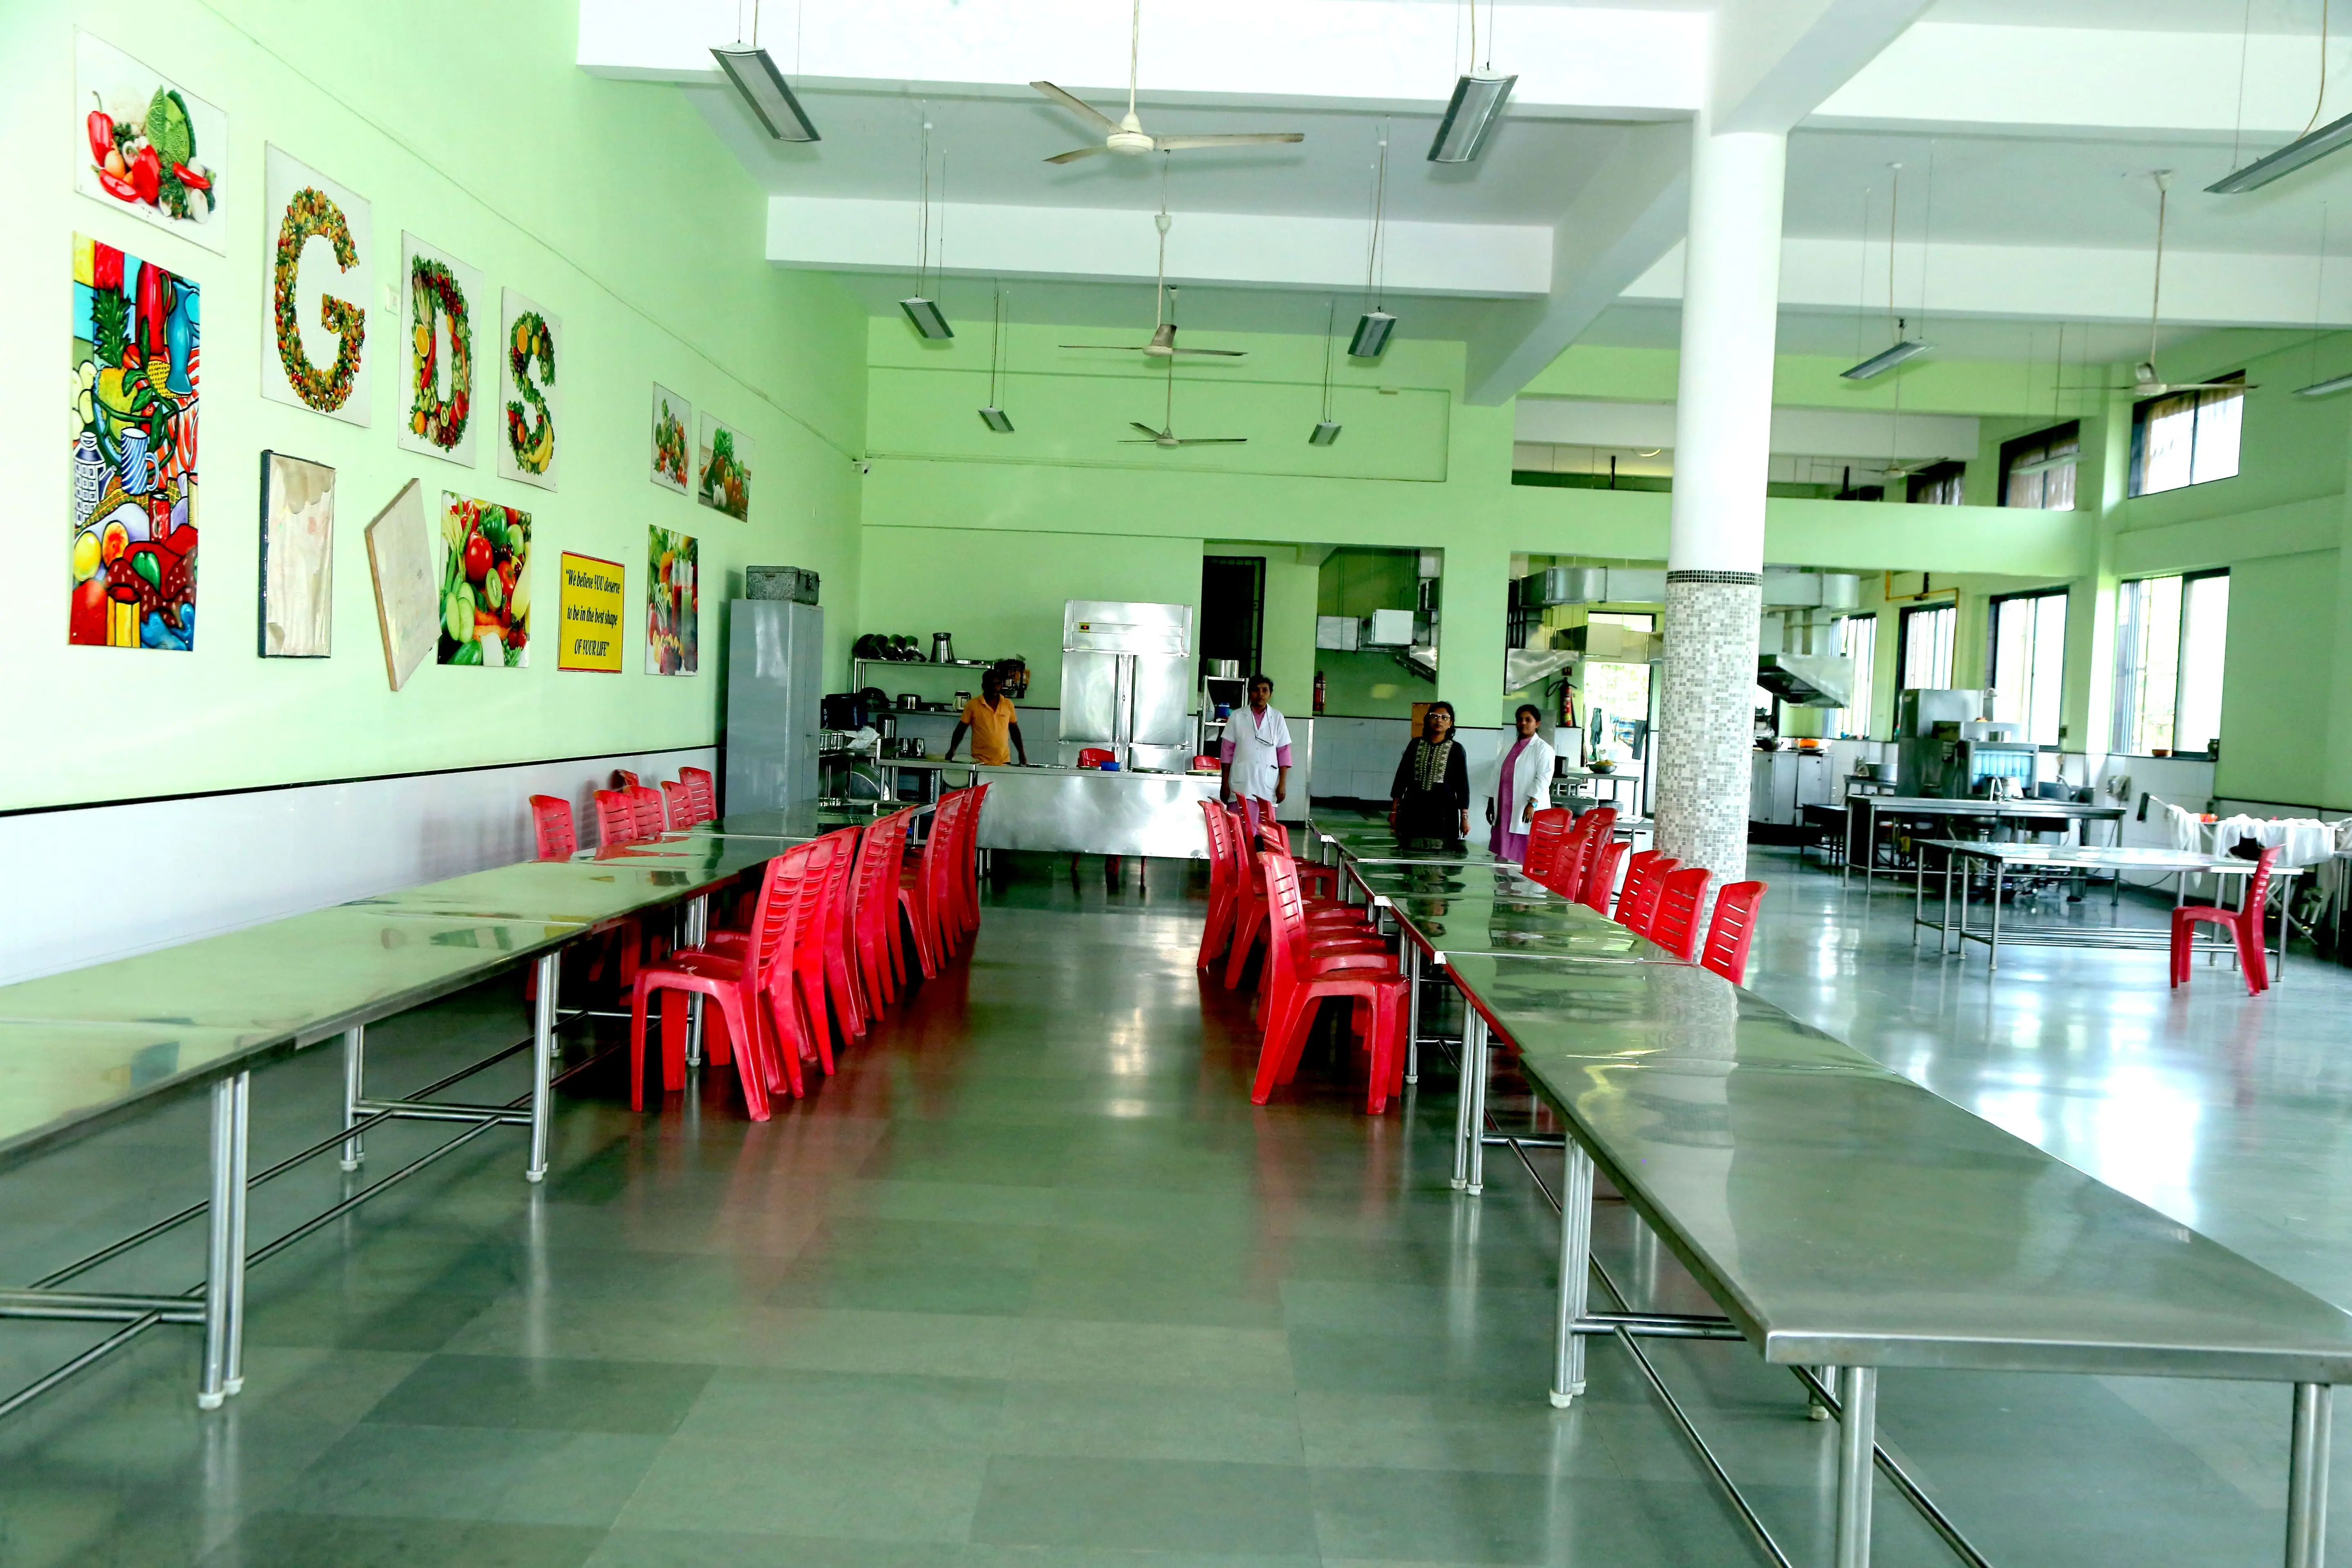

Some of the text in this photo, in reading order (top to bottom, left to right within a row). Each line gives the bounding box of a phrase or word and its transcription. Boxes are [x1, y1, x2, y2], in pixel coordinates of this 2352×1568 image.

[274, 185, 556, 475] G D S
[577, 571, 593, 589] believe
[595, 575, 604, 591] YOU
[604, 577, 620, 594] deserve
[567, 604, 617, 629] to be in the best shape
[575, 639, 582, 654] OF
[583, 639, 596, 655] YOUR
